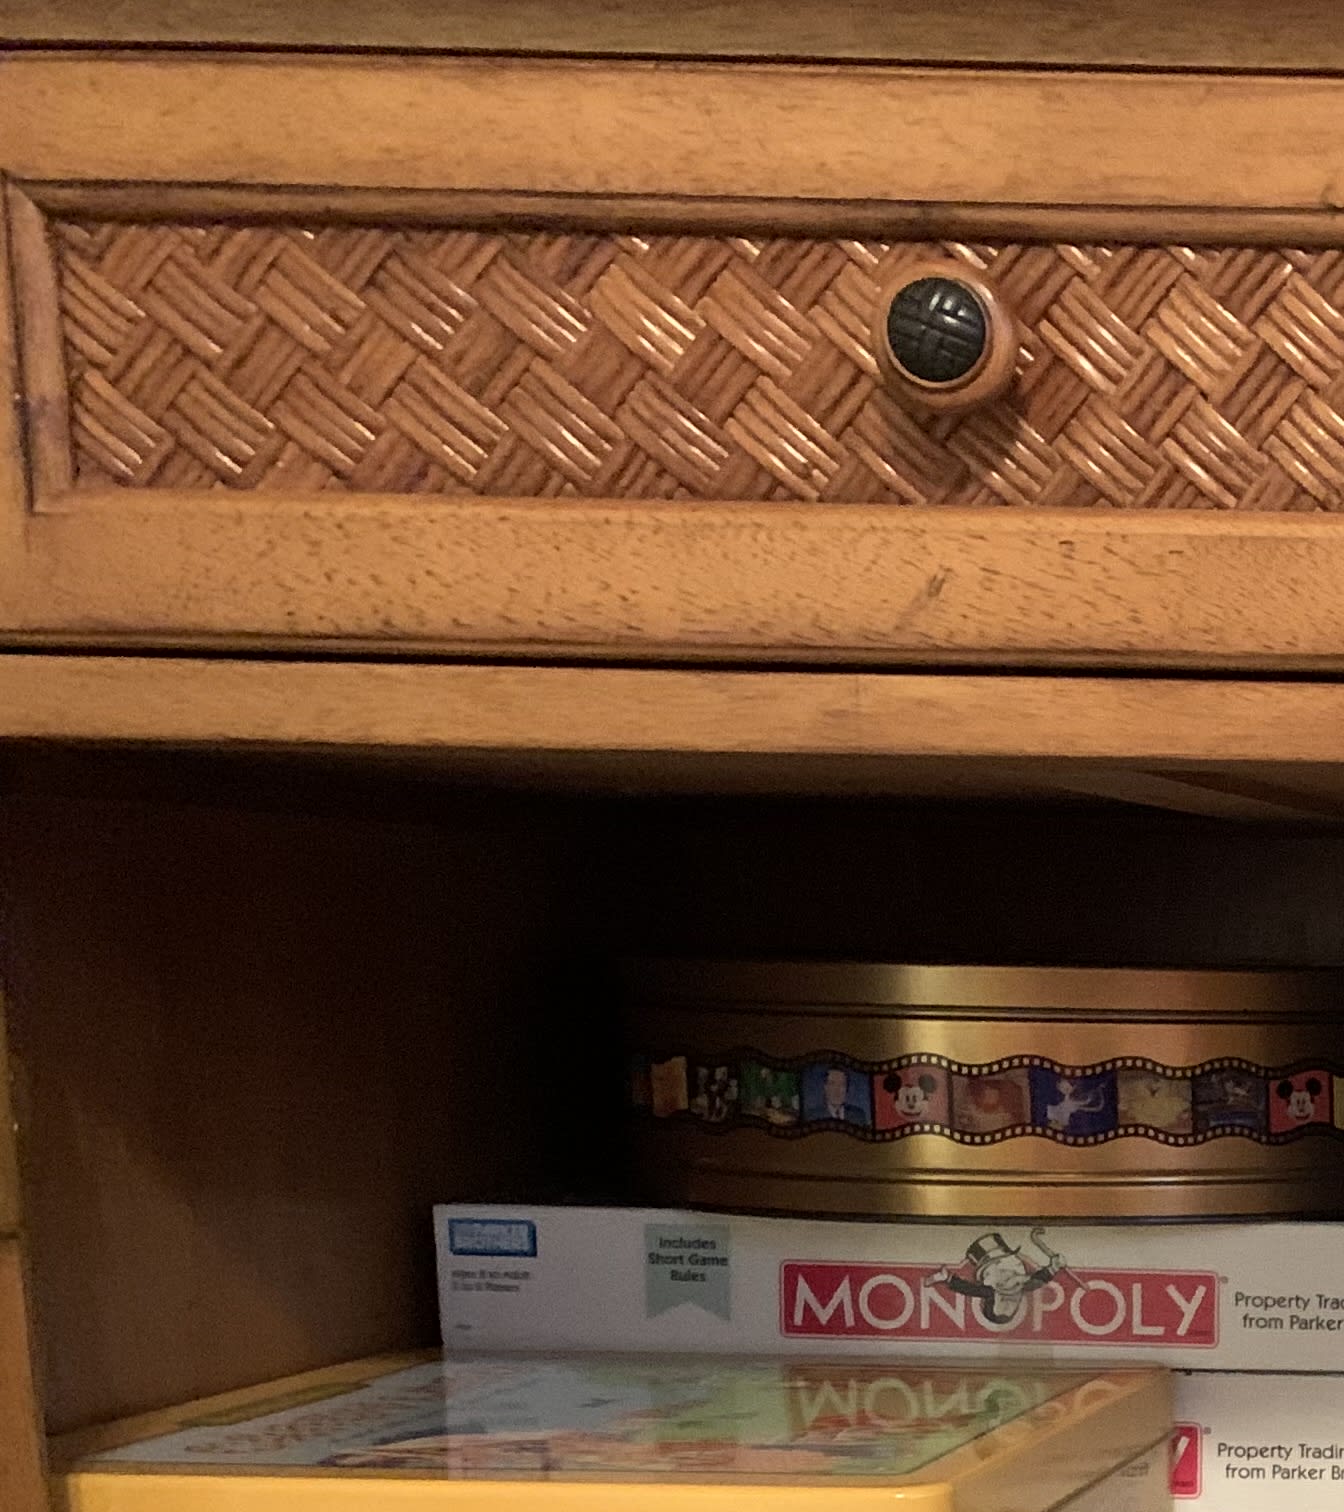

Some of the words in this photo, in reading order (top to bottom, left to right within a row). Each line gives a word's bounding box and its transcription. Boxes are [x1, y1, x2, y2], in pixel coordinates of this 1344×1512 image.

[658, 1236, 717, 1250] Includes
[647, 1253, 685, 1266] Short
[687, 1253, 729, 1266] Game
[669, 1269, 707, 1282] Rules
[793, 1272, 1207, 1337] MONOPOLY
[1234, 1291, 1311, 1311] Property
[1242, 1313, 1284, 1330] from
[1289, 1314, 1344, 1331] Parker
[1217, 1443, 1292, 1462] Property
[1225, 1463, 1266, 1480] from
[1272, 1465, 1326, 1481] Parker
